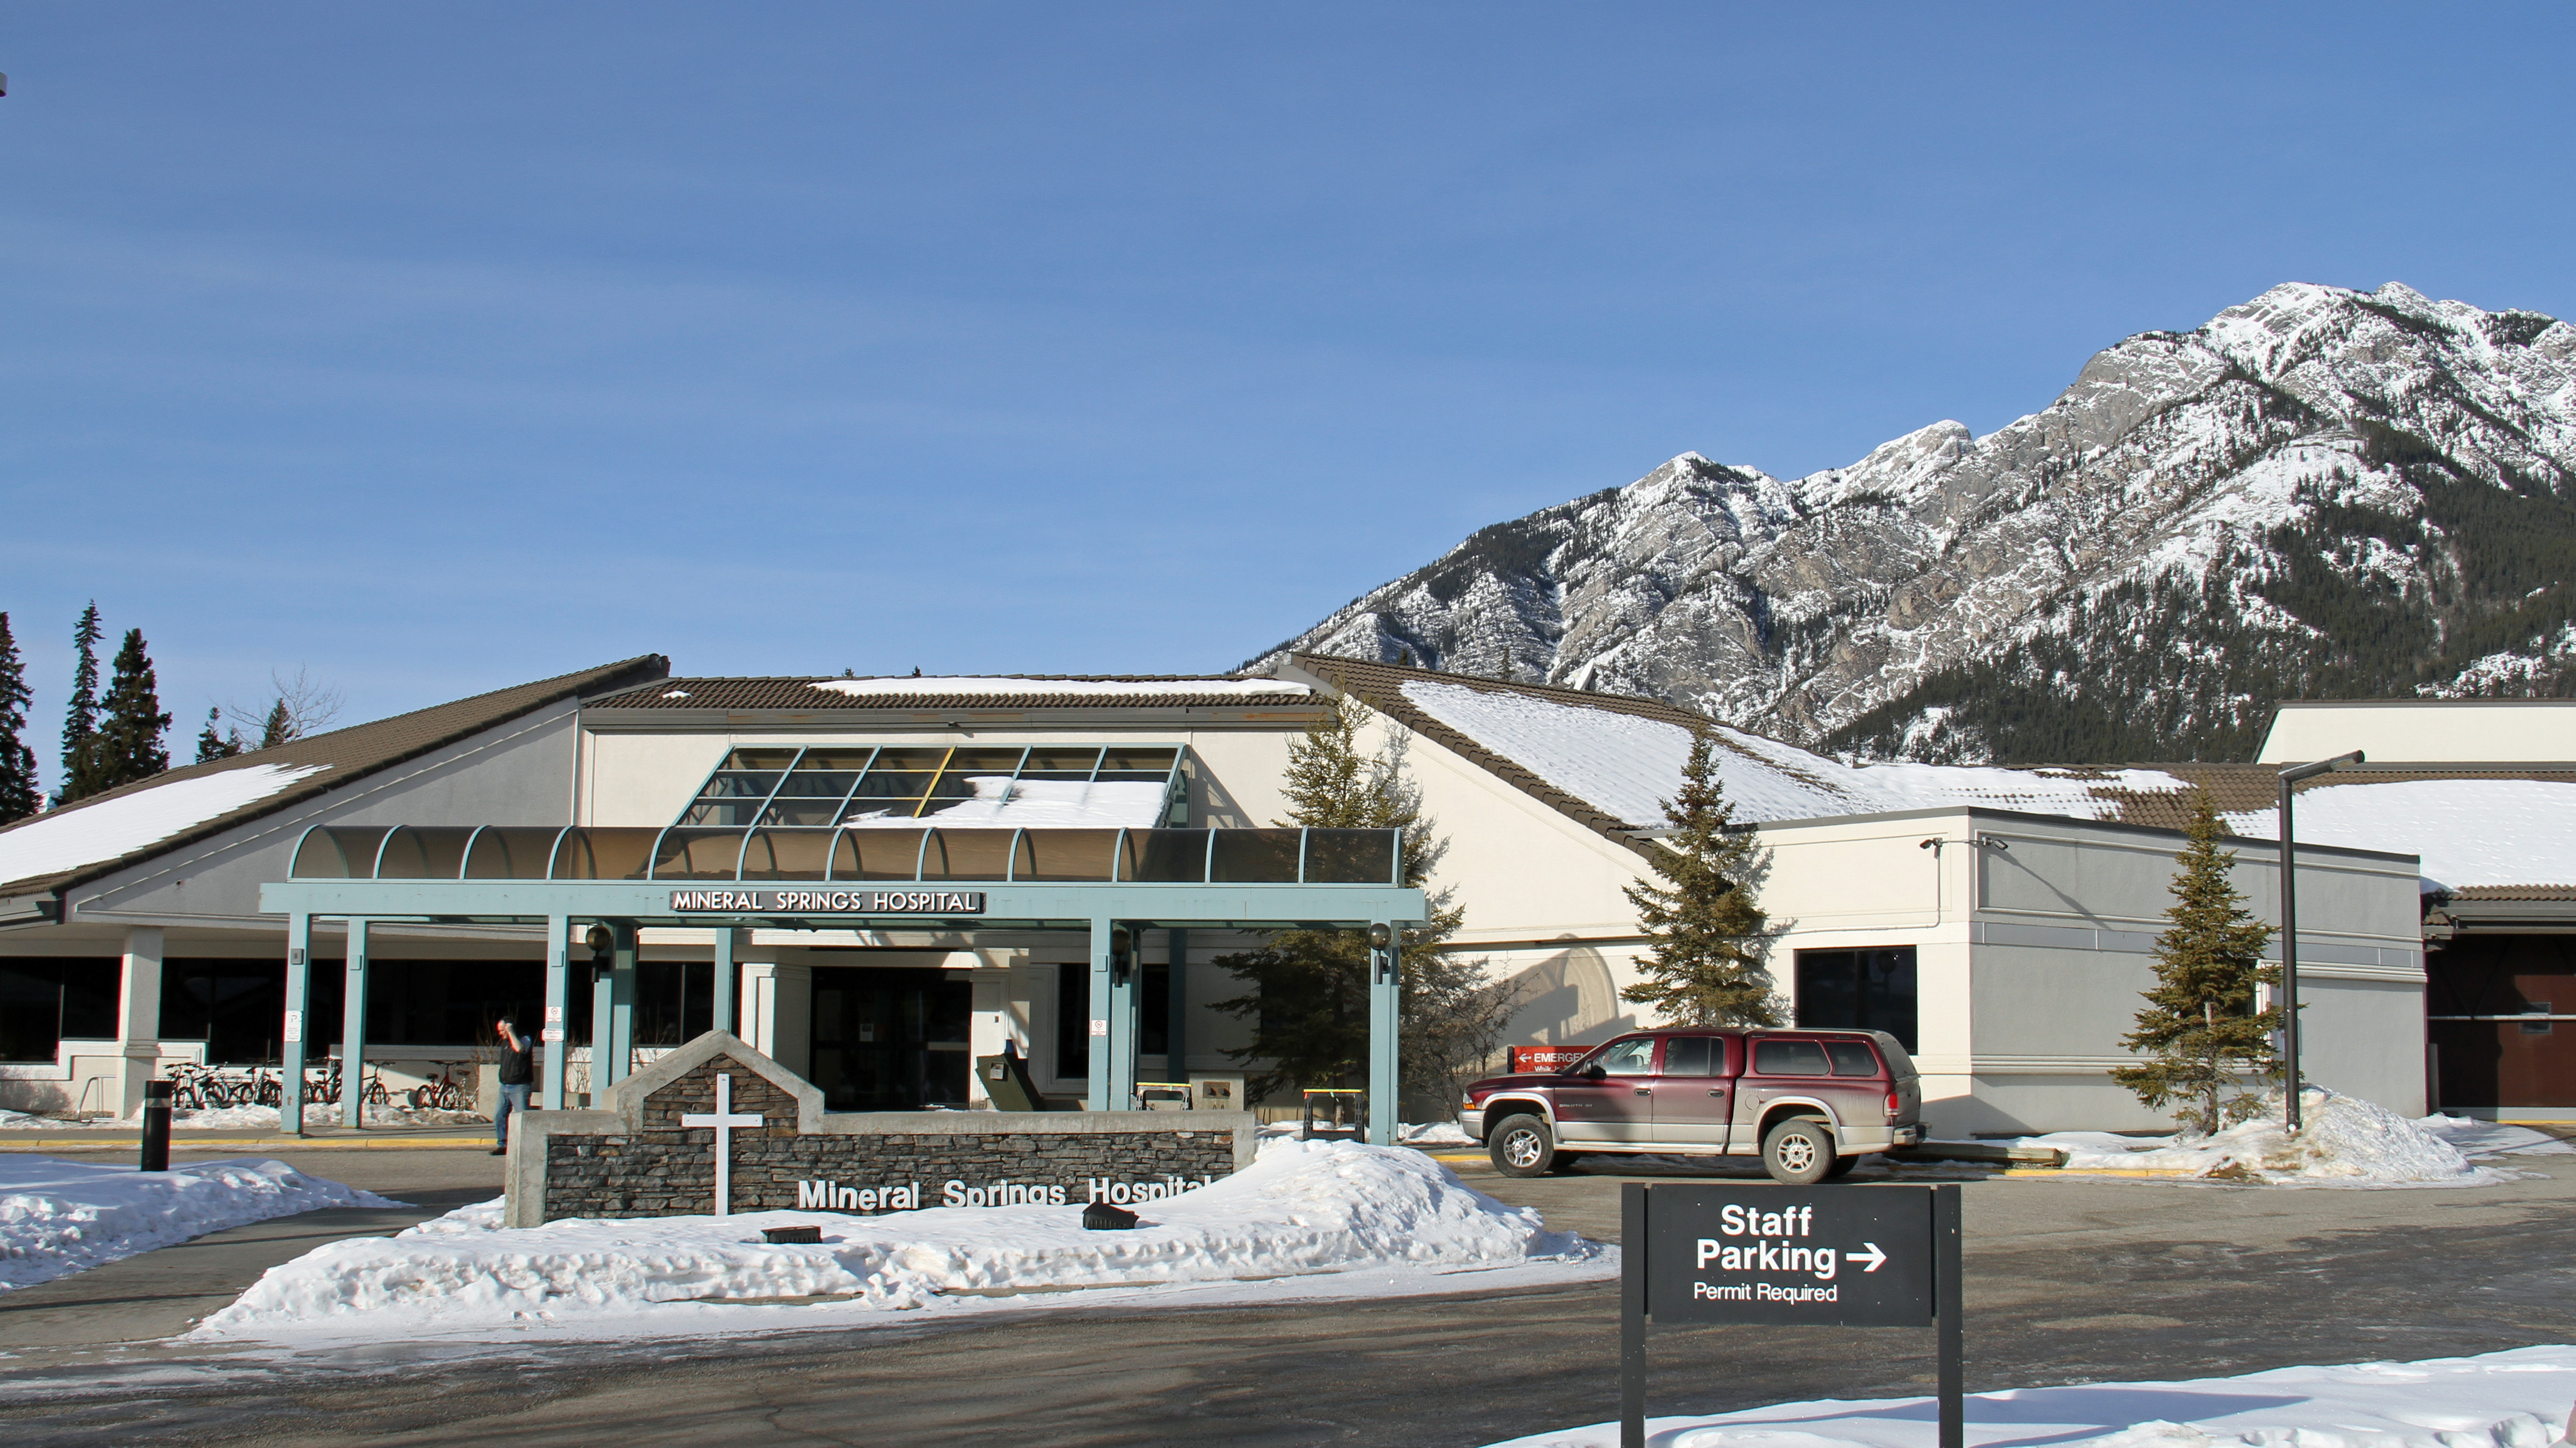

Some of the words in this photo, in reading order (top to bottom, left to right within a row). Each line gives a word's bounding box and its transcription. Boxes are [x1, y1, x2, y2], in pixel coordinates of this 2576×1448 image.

[674, 892, 763, 909] MINERAL
[776, 892, 860, 909] SPRINGS
[874, 892, 976, 910] HOSPITAL
[1534, 1052, 1584, 1063] EMERGE
[798, 1180, 919, 1210] Mineral
[943, 1179, 1066, 1207] Springs
[1721, 1204, 1812, 1236] Staff
[1697, 1239, 1836, 1279] Parking
[1694, 1281, 1751, 1301] Permit
[1757, 1282, 1837, 1305] Required
